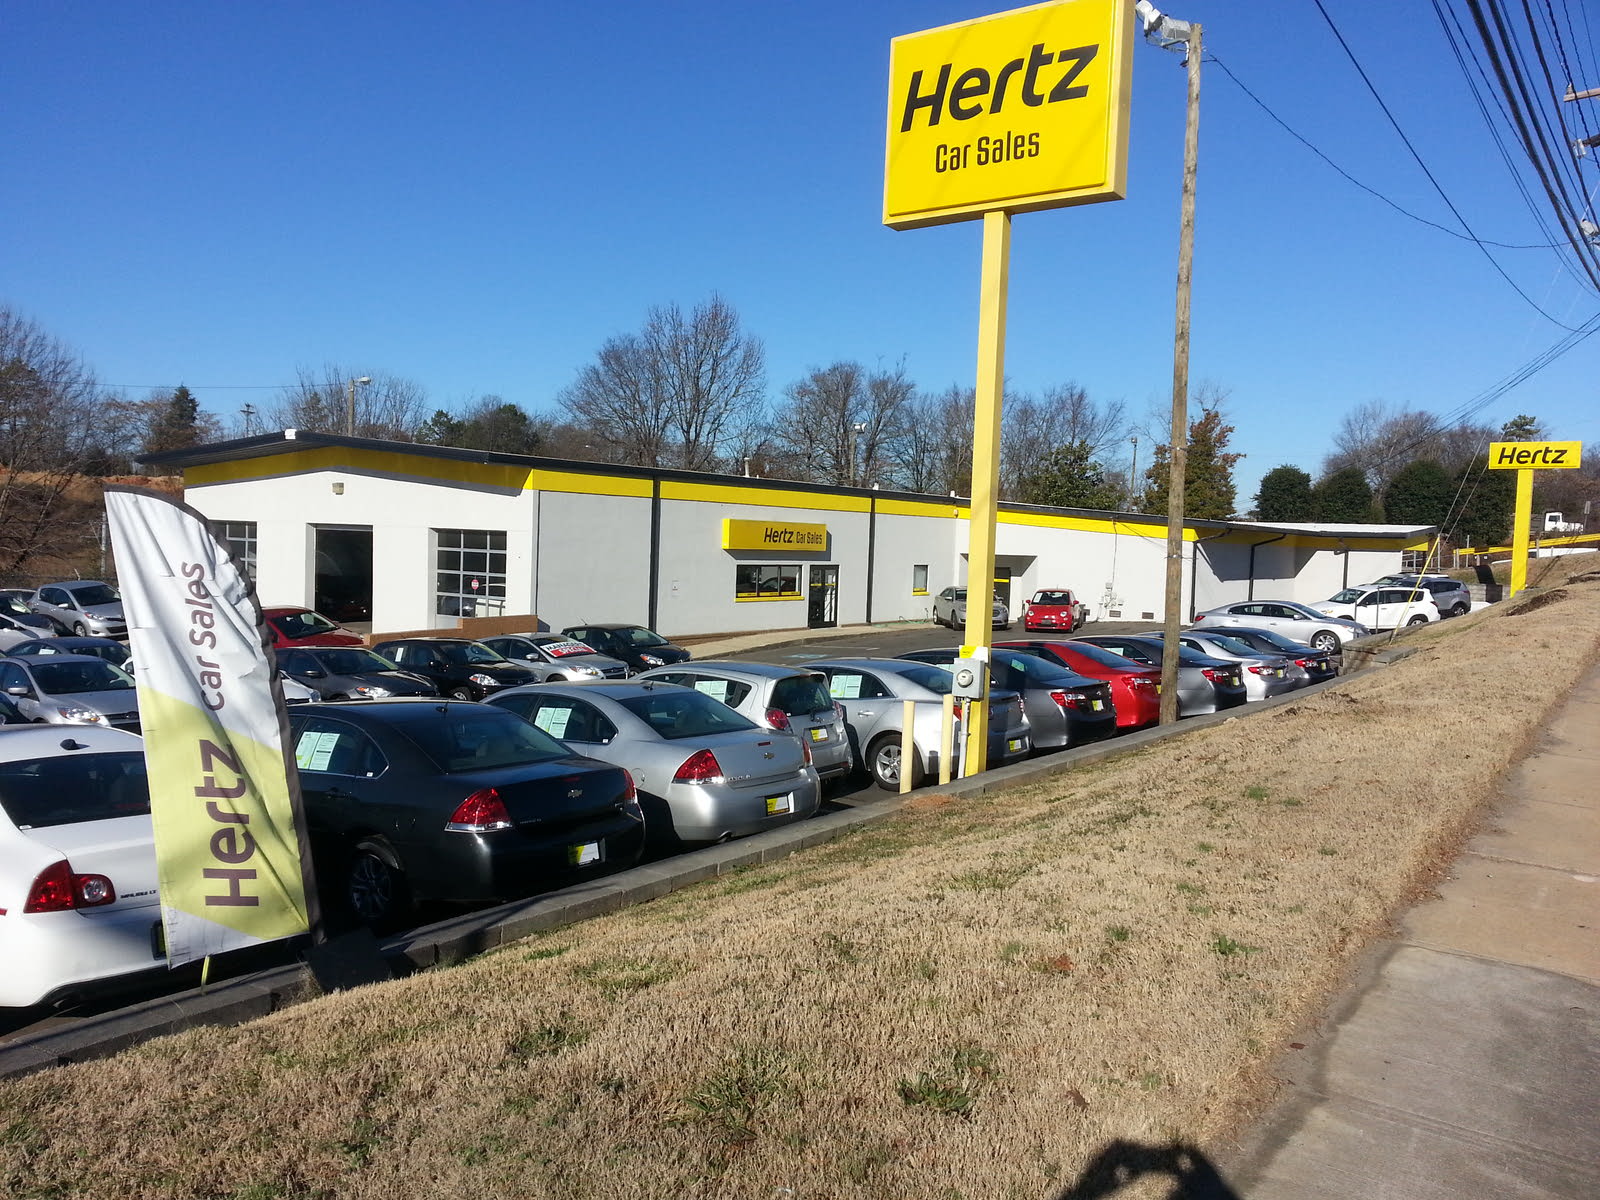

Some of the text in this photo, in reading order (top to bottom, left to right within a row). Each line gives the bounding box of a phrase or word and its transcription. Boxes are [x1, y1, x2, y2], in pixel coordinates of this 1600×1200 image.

[900, 43, 1099, 133] Hertz
[935, 130, 1040, 173] Car Sales
[1497, 446, 1568, 464] Hertz
[763, 527, 822, 544] Hertz Car Sales
[181, 561, 217, 650] Sales
[194, 739, 260, 906] Hertz
